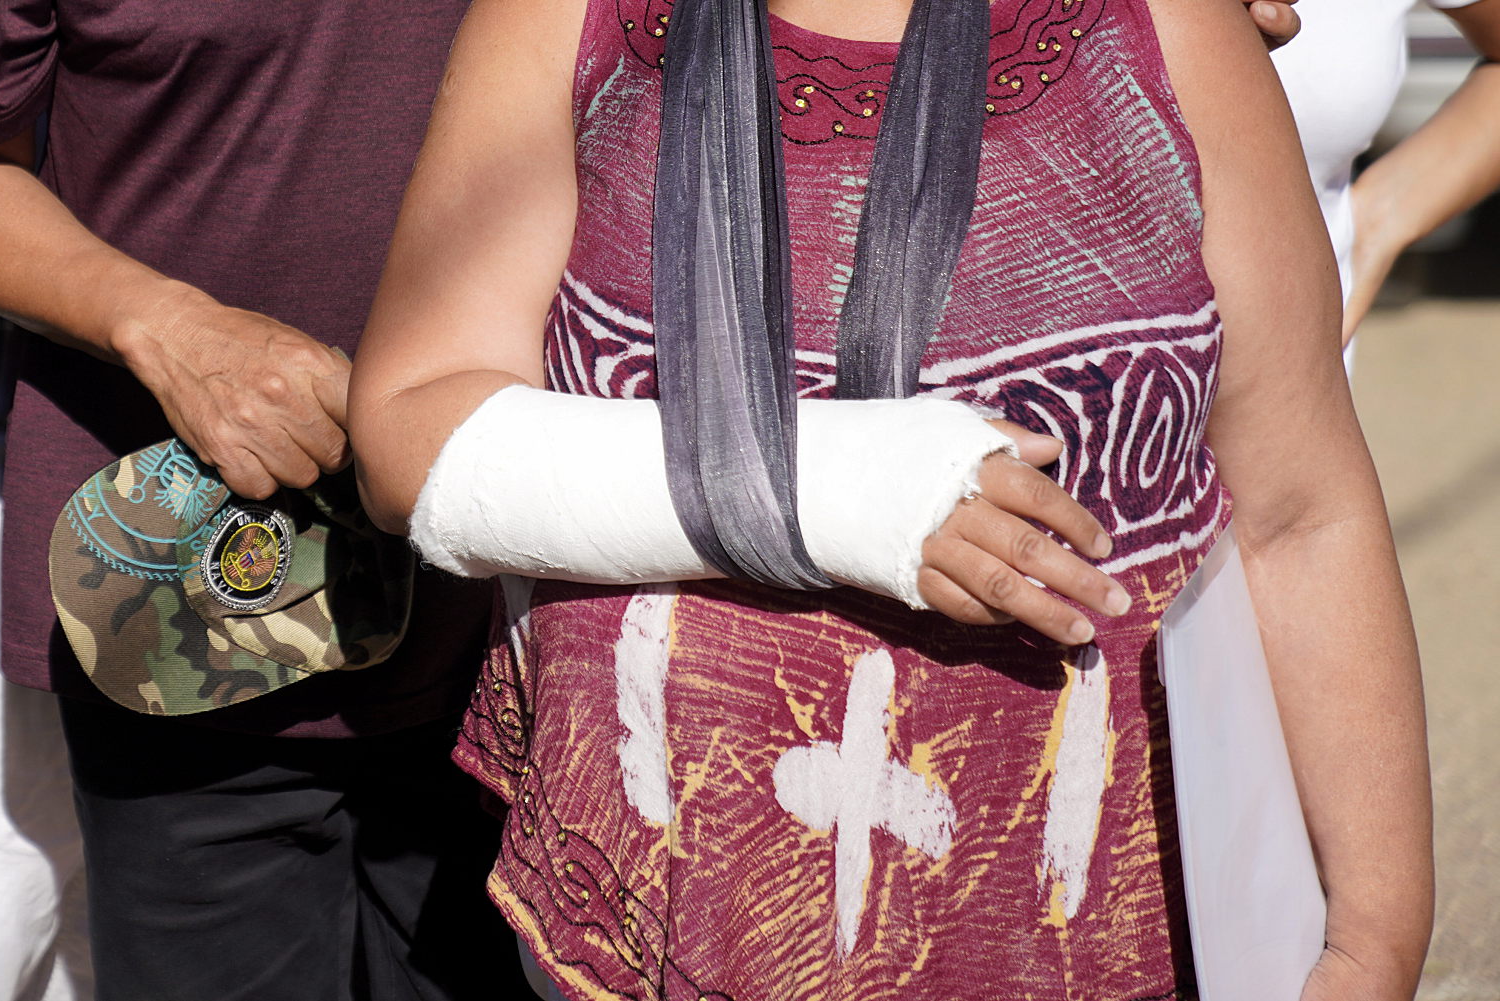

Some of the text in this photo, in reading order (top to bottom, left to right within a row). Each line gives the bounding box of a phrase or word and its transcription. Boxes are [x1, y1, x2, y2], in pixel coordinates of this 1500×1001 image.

[236, 513, 286, 586] UNITED STATES
[209, 561, 235, 596] NAVY
